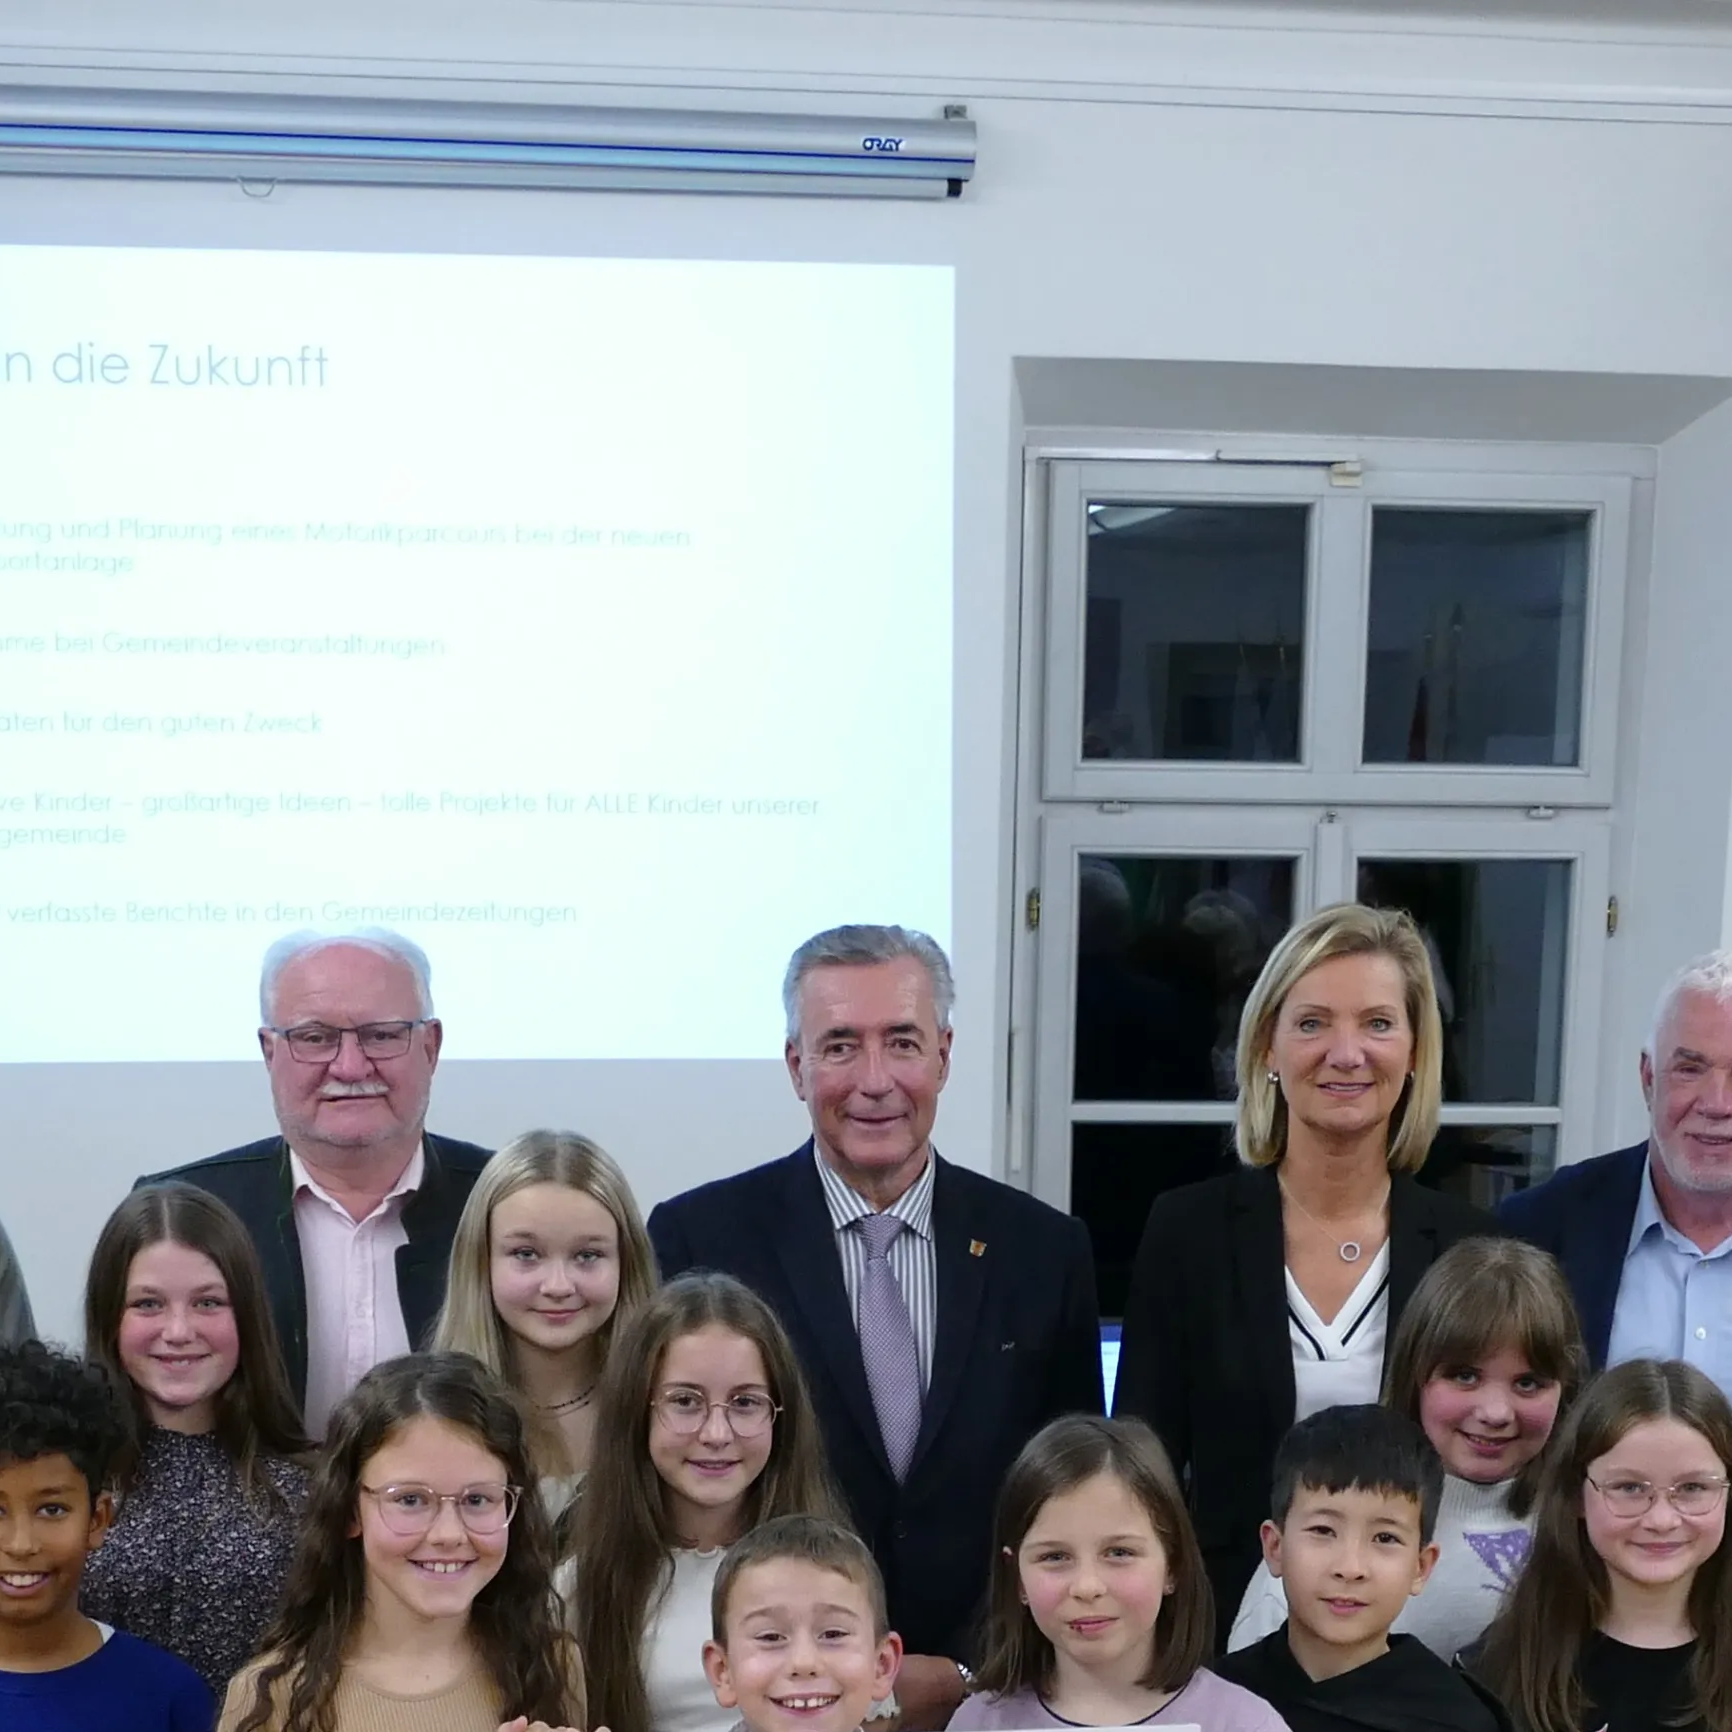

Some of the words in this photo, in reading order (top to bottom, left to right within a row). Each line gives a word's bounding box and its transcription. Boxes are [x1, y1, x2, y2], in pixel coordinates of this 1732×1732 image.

[863, 138, 903, 152] ORAY
[51, 341, 130, 386] die
[148, 342, 329, 388] Zukunft
[60, 519, 112, 539] und
[118, 517, 223, 548] Planung
[231, 524, 297, 542] eines
[514, 523, 556, 545] bei
[561, 524, 602, 546] der
[611, 529, 694, 548] neuen
[54, 630, 96, 654] bei
[102, 630, 447, 660] Gemeindeveranstaltungen
[101, 711, 153, 733] den
[159, 713, 238, 739] guten
[243, 710, 323, 734] Zweck
[33, 790, 114, 812] Kinder
[141, 790, 272, 819] großartige
[278, 792, 352, 813] Ideen
[379, 790, 432, 813] tolle
[439, 789, 538, 816] Projekte
[584, 793, 638, 814] ALLE
[647, 792, 723, 815] Kinder
[731, 798, 820, 816] unserer
[7, 901, 117, 923] verfasste
[125, 901, 229, 924] Berichte
[235, 901, 257, 923] in
[264, 900, 313, 922] den
[322, 900, 578, 931] Gemeindezeitungen
